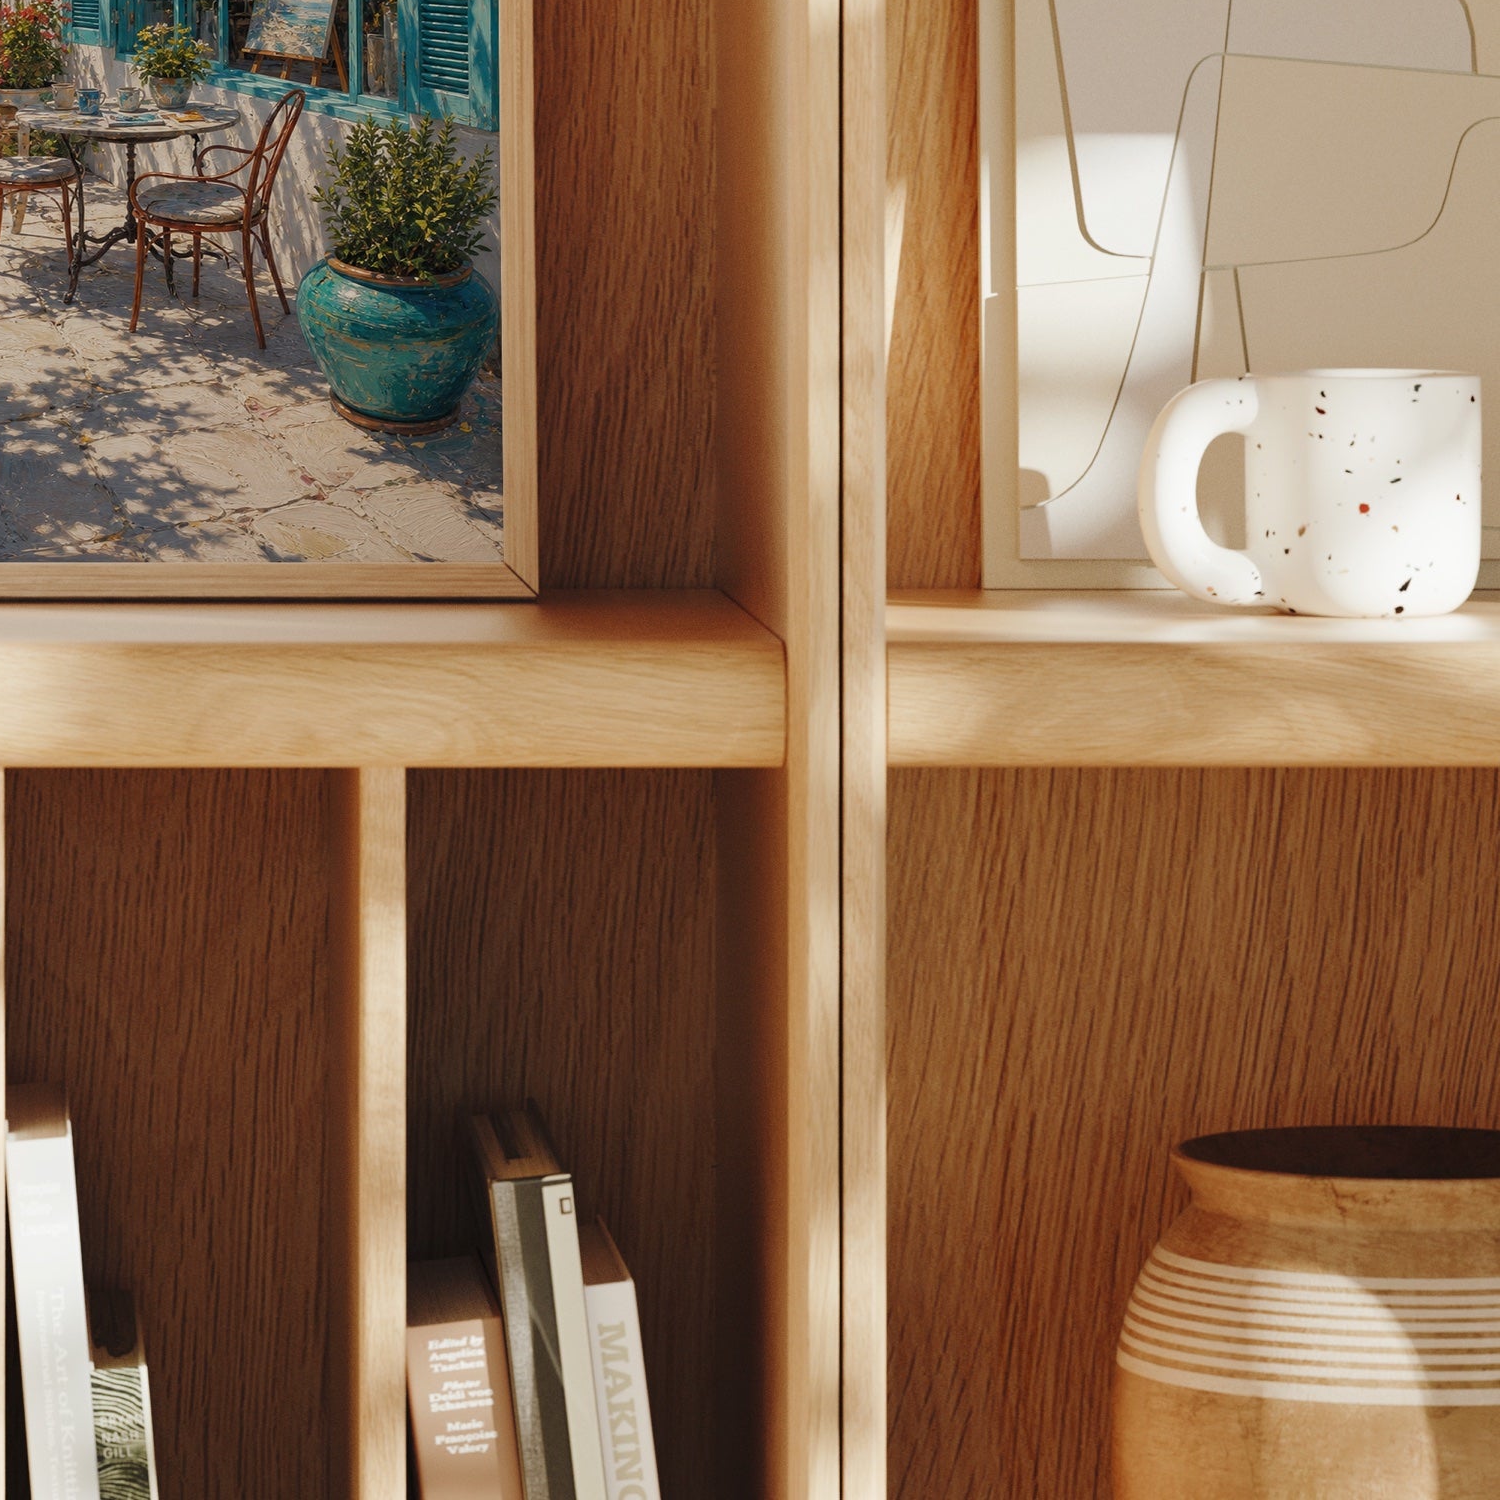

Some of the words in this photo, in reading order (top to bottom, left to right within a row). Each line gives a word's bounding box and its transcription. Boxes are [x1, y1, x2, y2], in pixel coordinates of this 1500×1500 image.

[428, 1336, 468, 1350] Edited
[470, 1335, 484, 1348] by
[53, 1342, 69, 1384] Art
[57, 1391, 74, 1418] of
[102, 1445, 133, 1459] GILL
